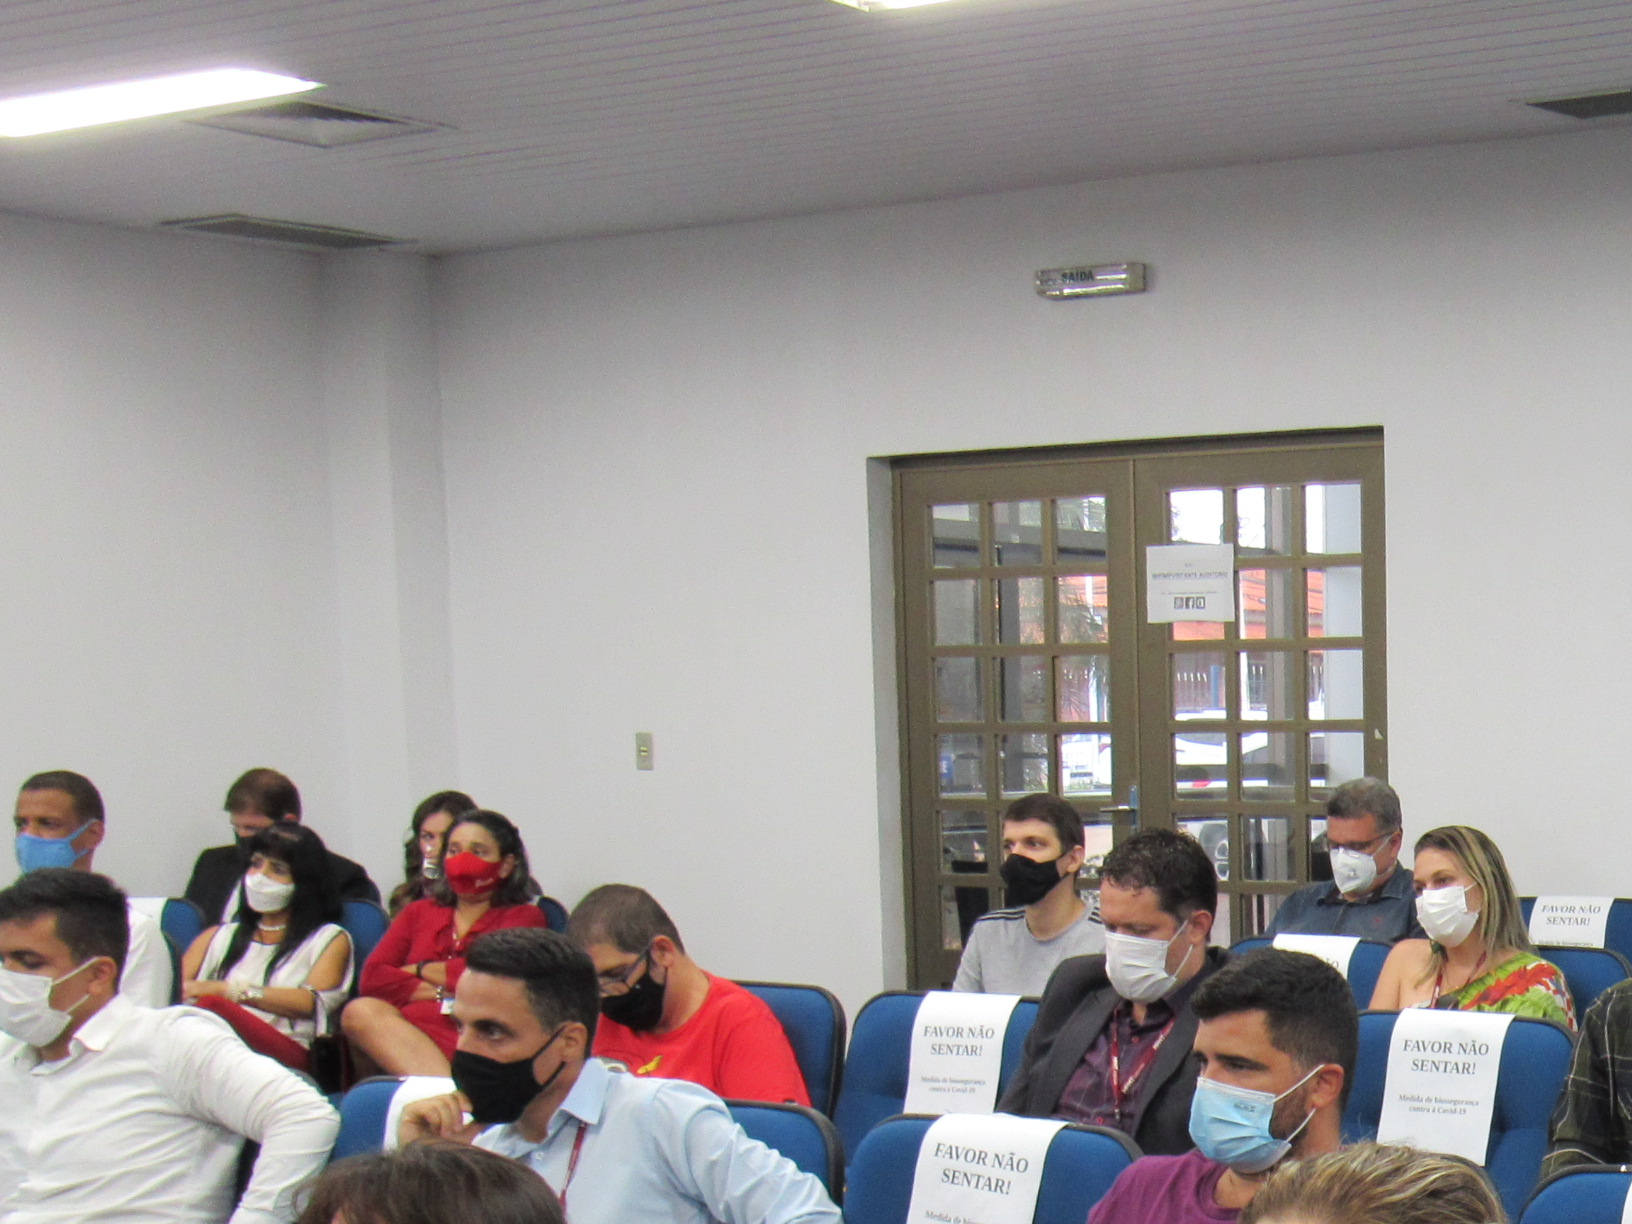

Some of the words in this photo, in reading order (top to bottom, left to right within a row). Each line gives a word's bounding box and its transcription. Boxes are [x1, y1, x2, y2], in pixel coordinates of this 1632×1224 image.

[1542, 905, 1576, 913] FAVOR
[1578, 904, 1600, 914] NÃO
[1546, 917, 1590, 926] SENTAR!
[924, 1026, 964, 1038] FAVOR
[967, 1025, 994, 1039] NÃO
[930, 1044, 983, 1056] SENTAR!
[1403, 1040, 1452, 1054] FAVOR
[1457, 1040, 1489, 1055] NÃO
[1411, 1059, 1475, 1075] SENTAR!
[934, 1142, 988, 1166] FAVOR
[991, 1152, 1028, 1173] NÃO
[942, 1168, 1011, 1195] SENTAR!
